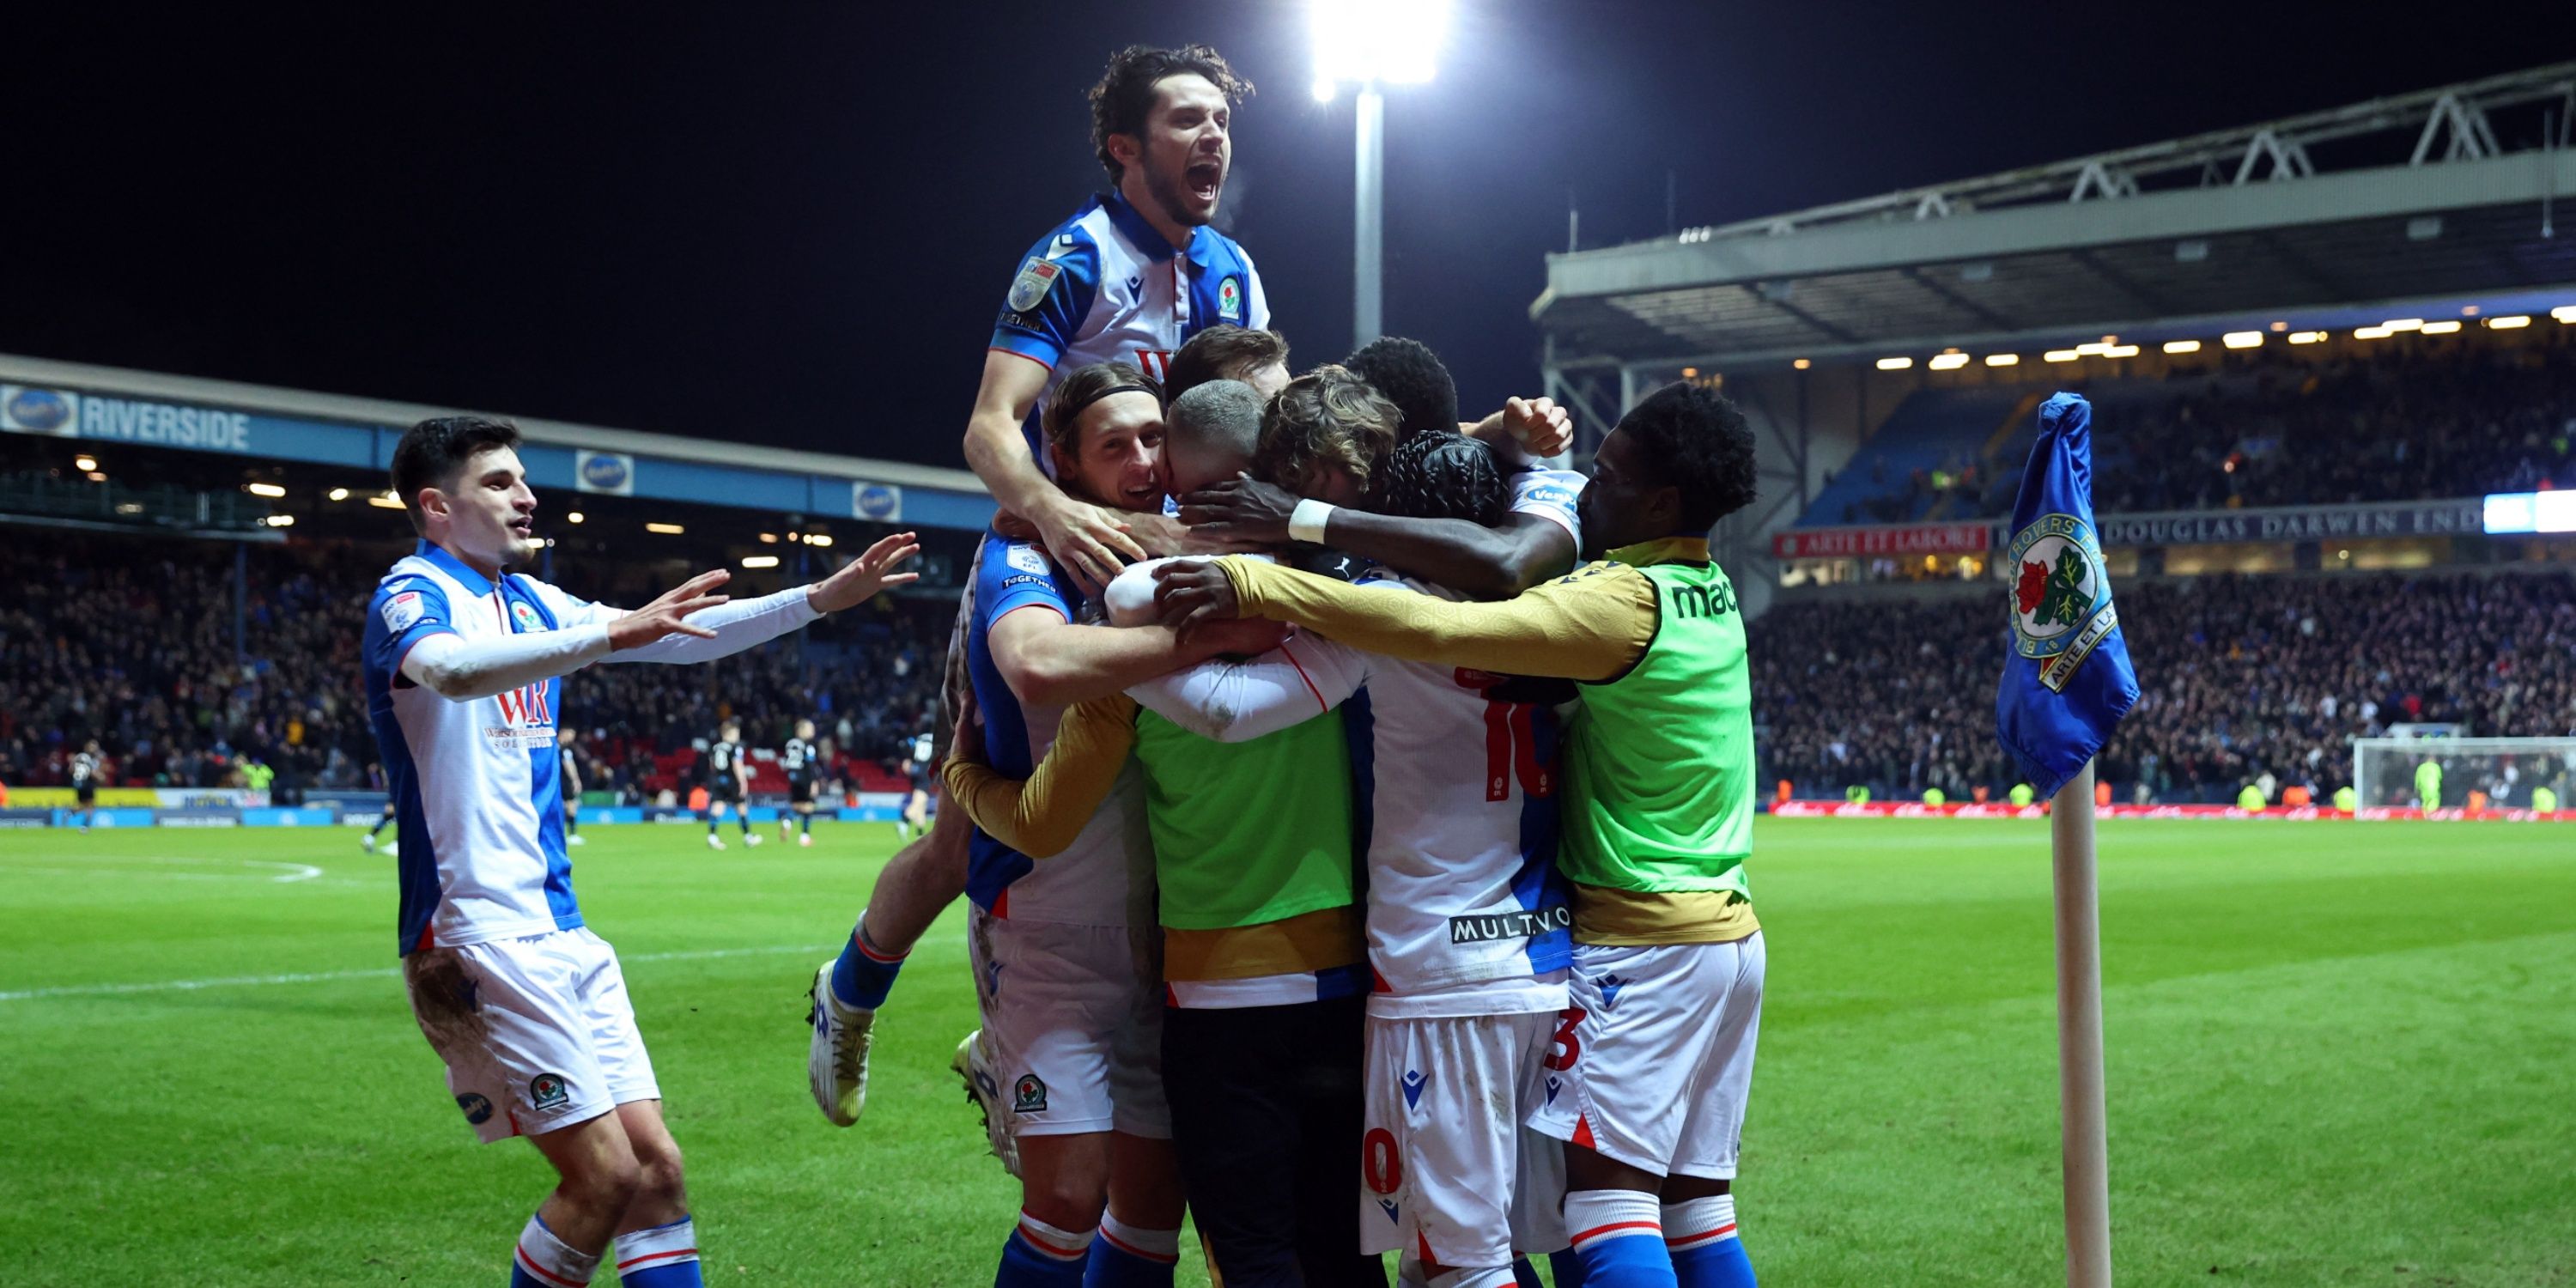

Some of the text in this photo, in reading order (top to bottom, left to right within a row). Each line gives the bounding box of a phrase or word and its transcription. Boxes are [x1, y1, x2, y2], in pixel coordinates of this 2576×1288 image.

[86, 397, 249, 451] RIVERSIDE
[2012, 517, 2075, 556] ROVERS
[2105, 507, 2484, 544] DOUGLAS DARWEN END
[2051, 645, 2082, 684] ARTE
[2081, 623, 2098, 646] ET
[1454, 907, 1571, 941] MULTVO
[1543, 1005, 1588, 1072] 3
